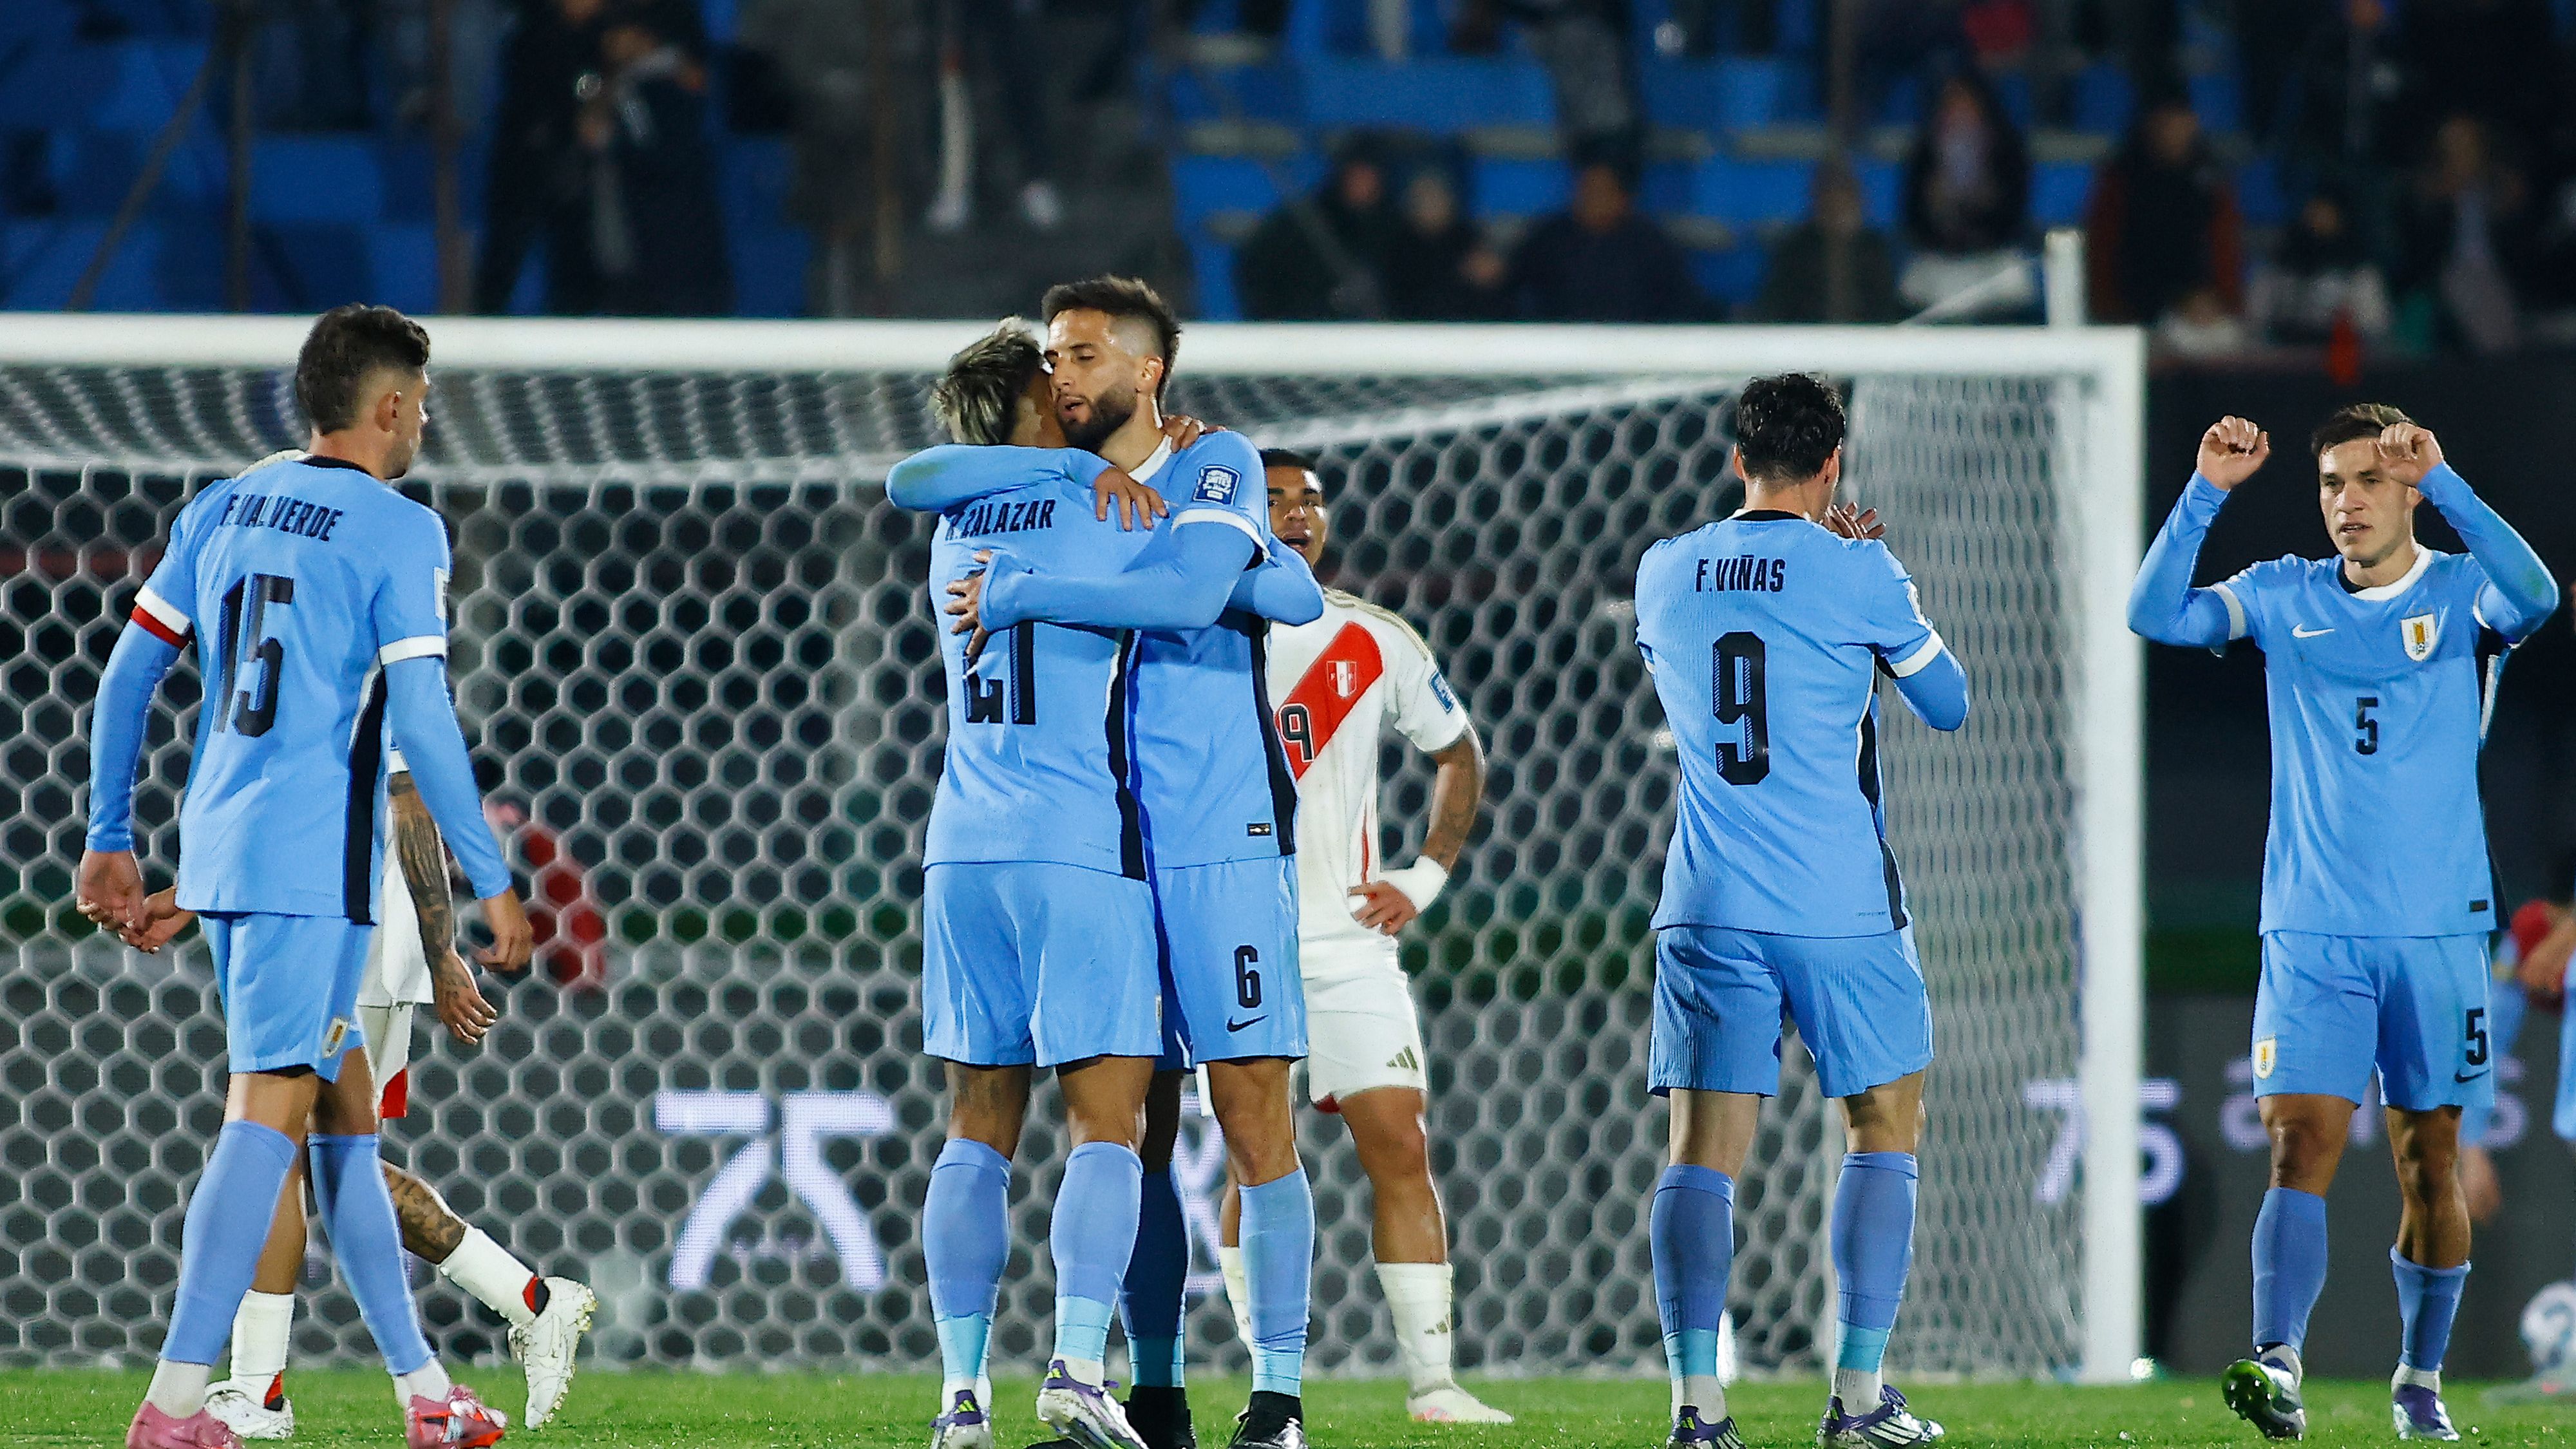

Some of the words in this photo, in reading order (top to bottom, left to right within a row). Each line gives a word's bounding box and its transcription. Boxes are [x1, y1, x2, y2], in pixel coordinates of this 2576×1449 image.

[1696, 554, 1785, 592] F.VIÑAS
[213, 573, 294, 735] 15
[1279, 703, 1314, 762] 9
[1712, 630, 1770, 786] 9
[2355, 697, 2378, 754] 5
[1235, 945, 1262, 1009] 6
[2466, 1007, 2486, 1066] 5
